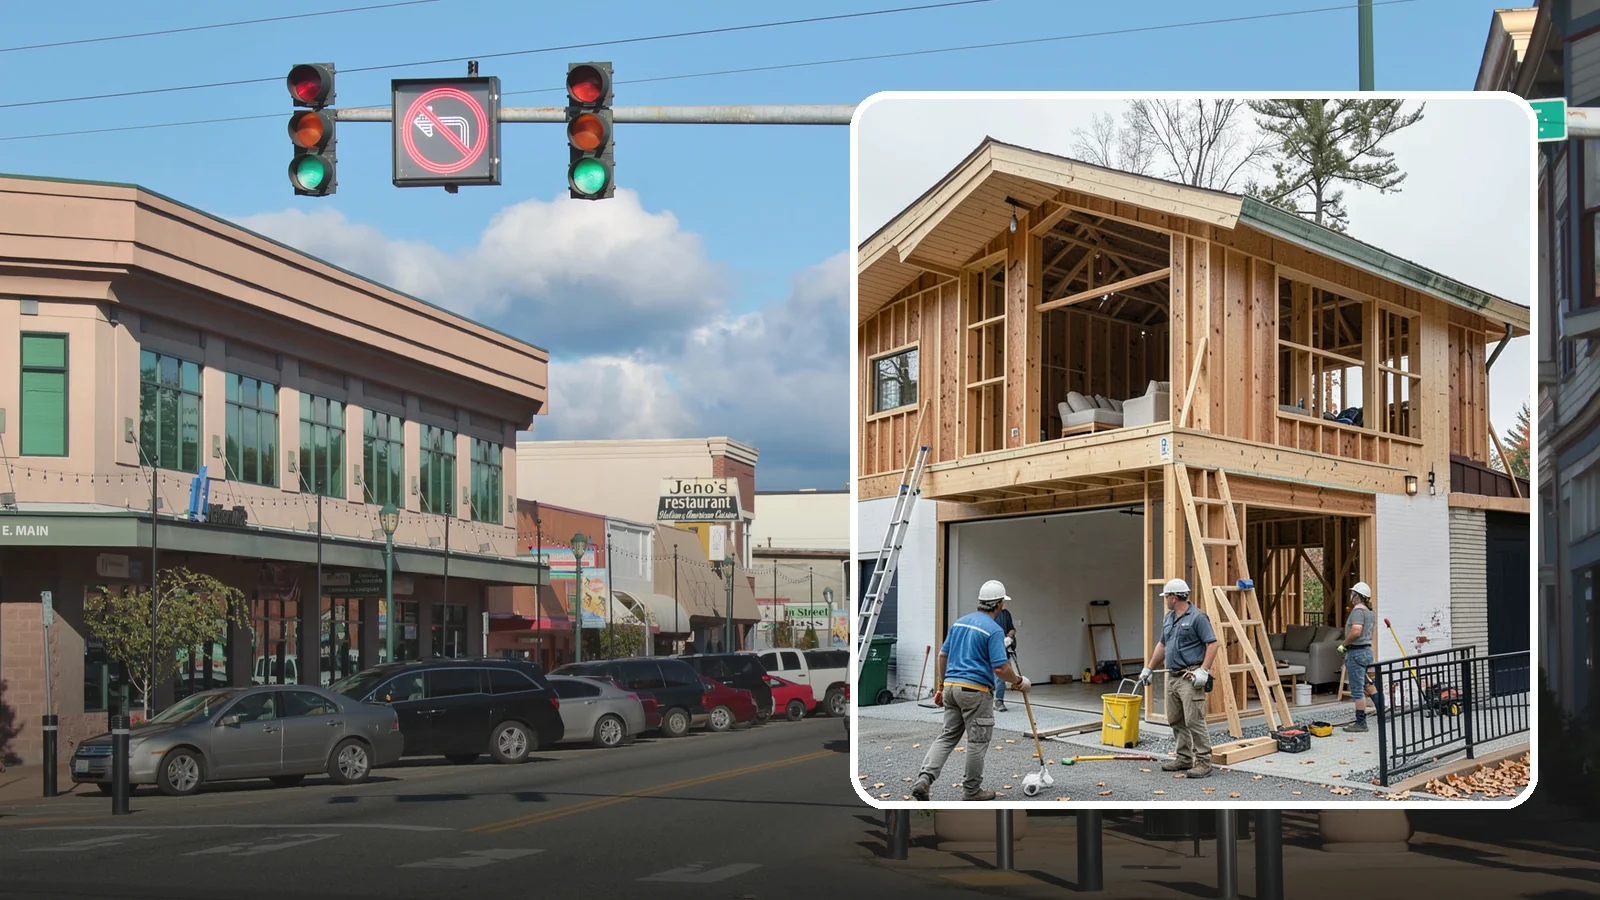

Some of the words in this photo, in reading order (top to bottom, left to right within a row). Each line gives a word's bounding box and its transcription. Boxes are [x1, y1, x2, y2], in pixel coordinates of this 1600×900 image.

[669, 480, 727, 494] Jeno's
[665, 496, 731, 509] restaurant
[686, 510, 714, 519] American
[715, 509, 737, 519] Cuisine
[2, 525, 13, 536] E.
[15, 525, 49, 536] MAIN
[786, 607, 795, 617] in
[797, 607, 829, 617] Street
[790, 619, 824, 627] lass
